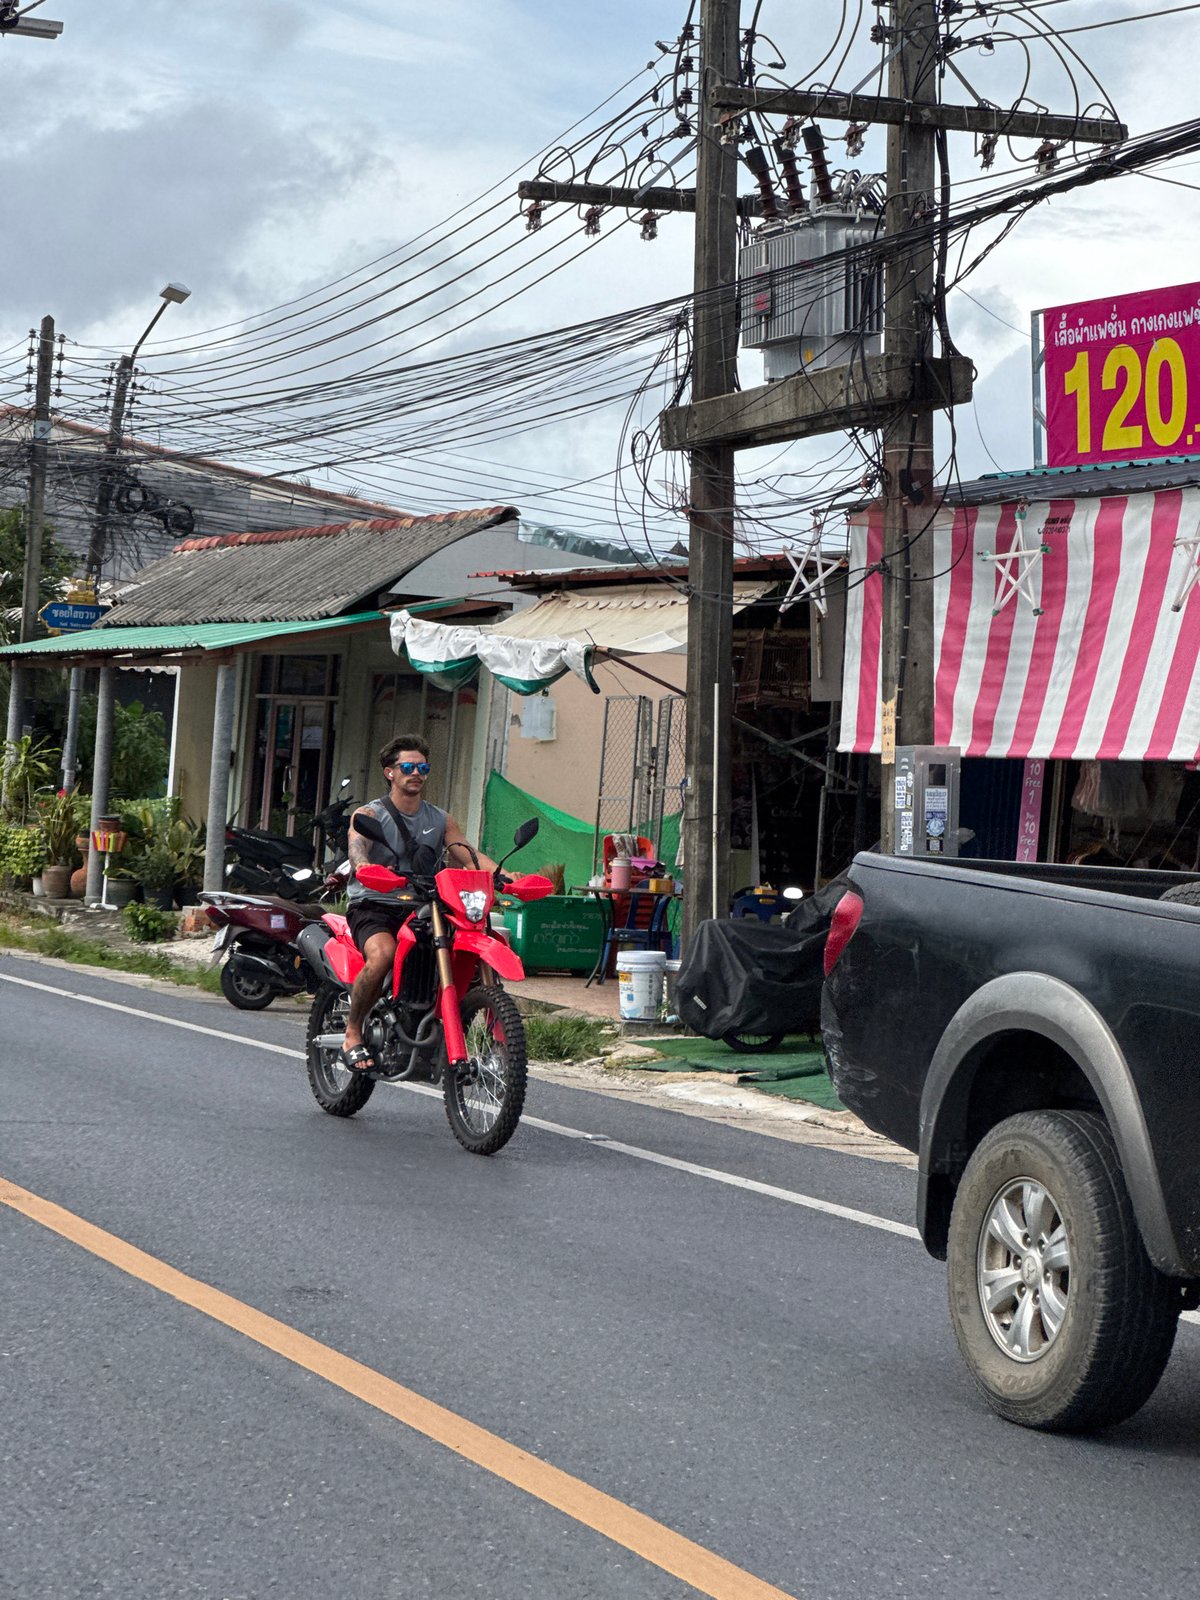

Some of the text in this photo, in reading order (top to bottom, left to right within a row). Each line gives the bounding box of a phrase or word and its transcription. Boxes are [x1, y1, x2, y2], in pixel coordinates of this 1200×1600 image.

[1054, 304, 1127, 347] เสื้อผ้าแฟชั่น
[1030, 763, 1041, 775] 10
[1025, 777, 1041, 788] Free
[1028, 789, 1035, 805] 1
[1024, 821, 1036, 834] 10
[1020, 835, 1036, 846] Free
